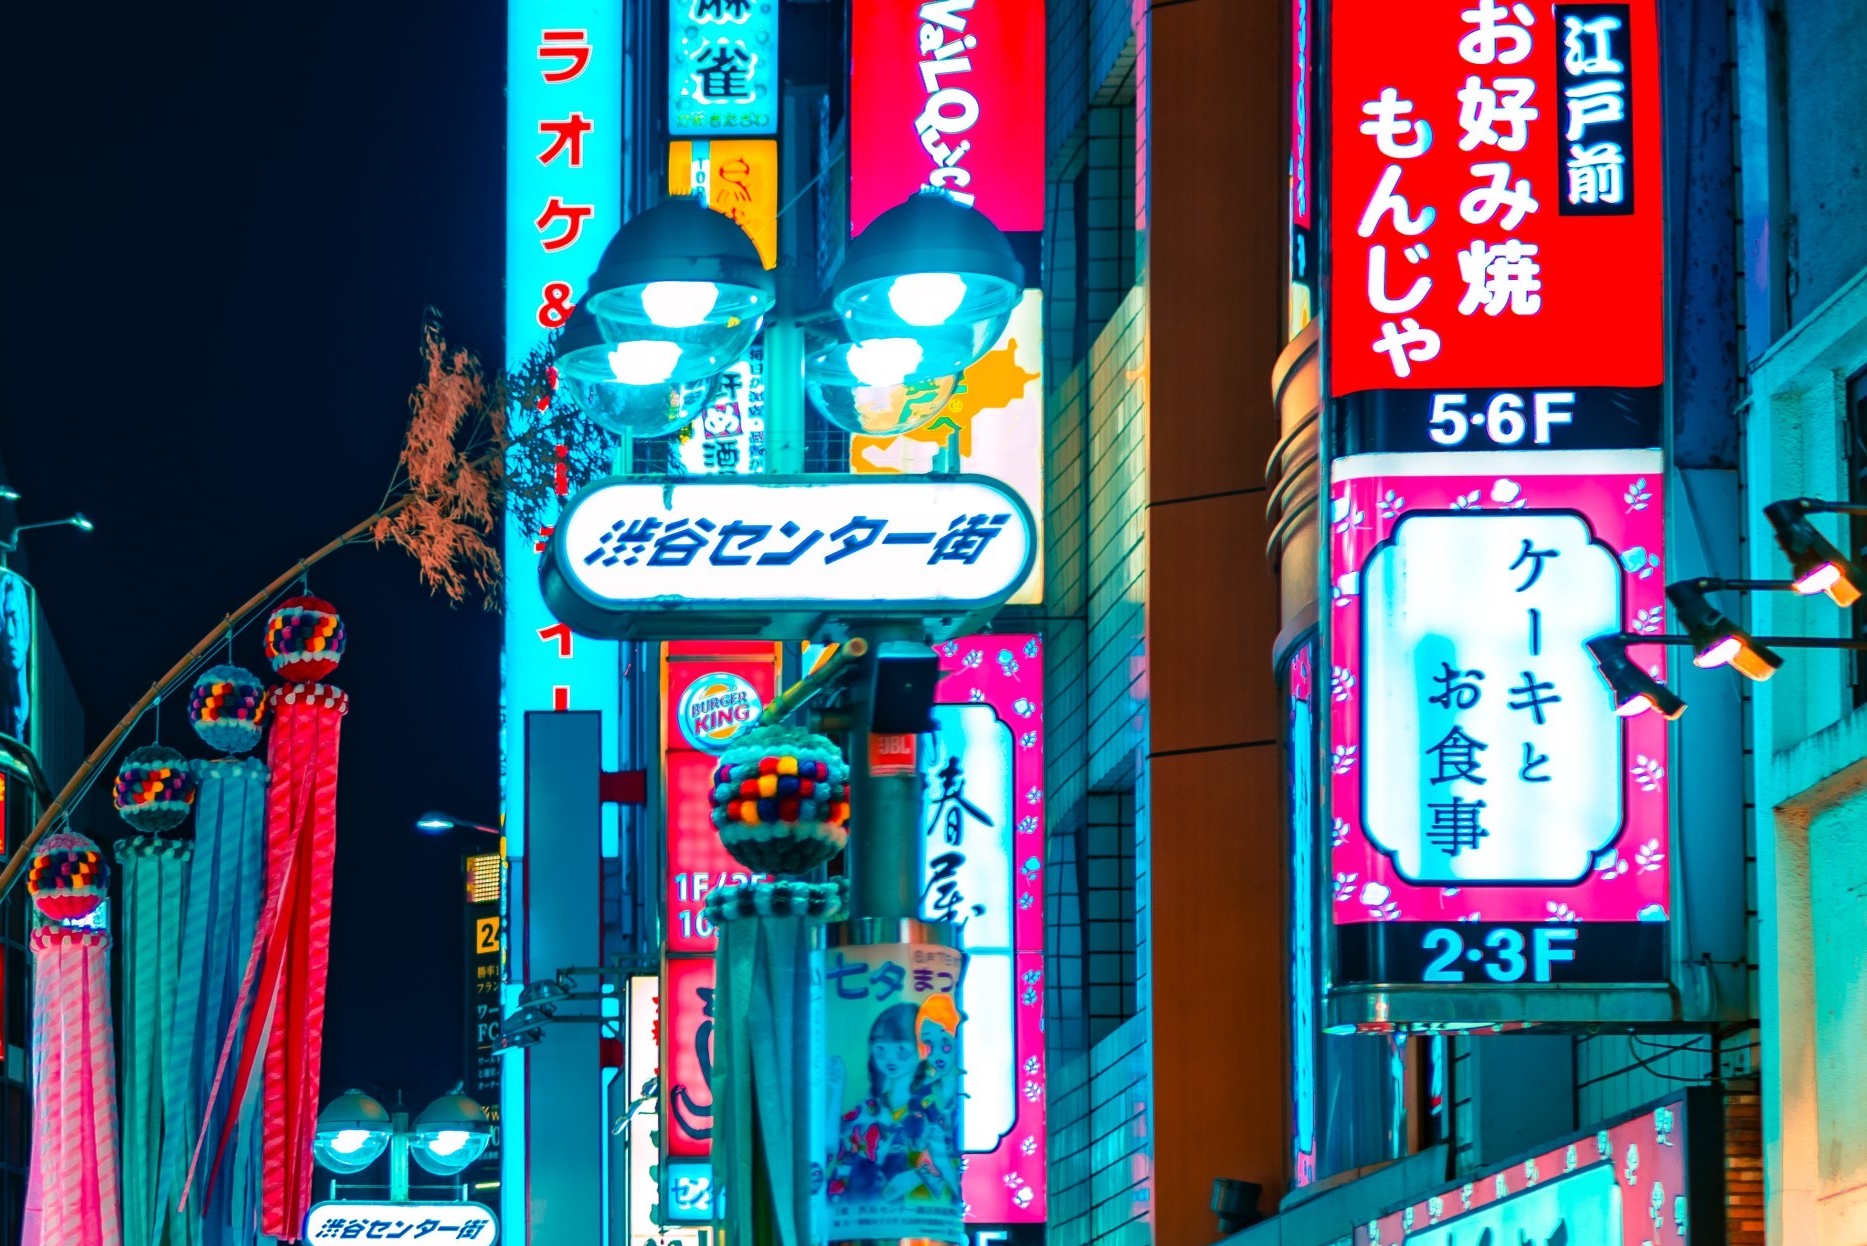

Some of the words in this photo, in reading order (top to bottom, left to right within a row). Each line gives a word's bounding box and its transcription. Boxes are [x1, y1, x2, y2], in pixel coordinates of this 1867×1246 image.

[1458, 0, 1541, 316] お好み焼
[1563, 16, 1626, 205] 江戸前
[1357, 88, 1442, 378] もんじゃ
[583, 513, 1011, 569] 渋谷センター街
[691, 690, 748, 718] BURGER
[694, 703, 751, 737] KING
[1507, 538, 1562, 785] ケーキと
[879, 735, 910, 755] JBL
[1425, 661, 1489, 858] お食事
[316, 1219, 489, 1240] 渋谷センター街
